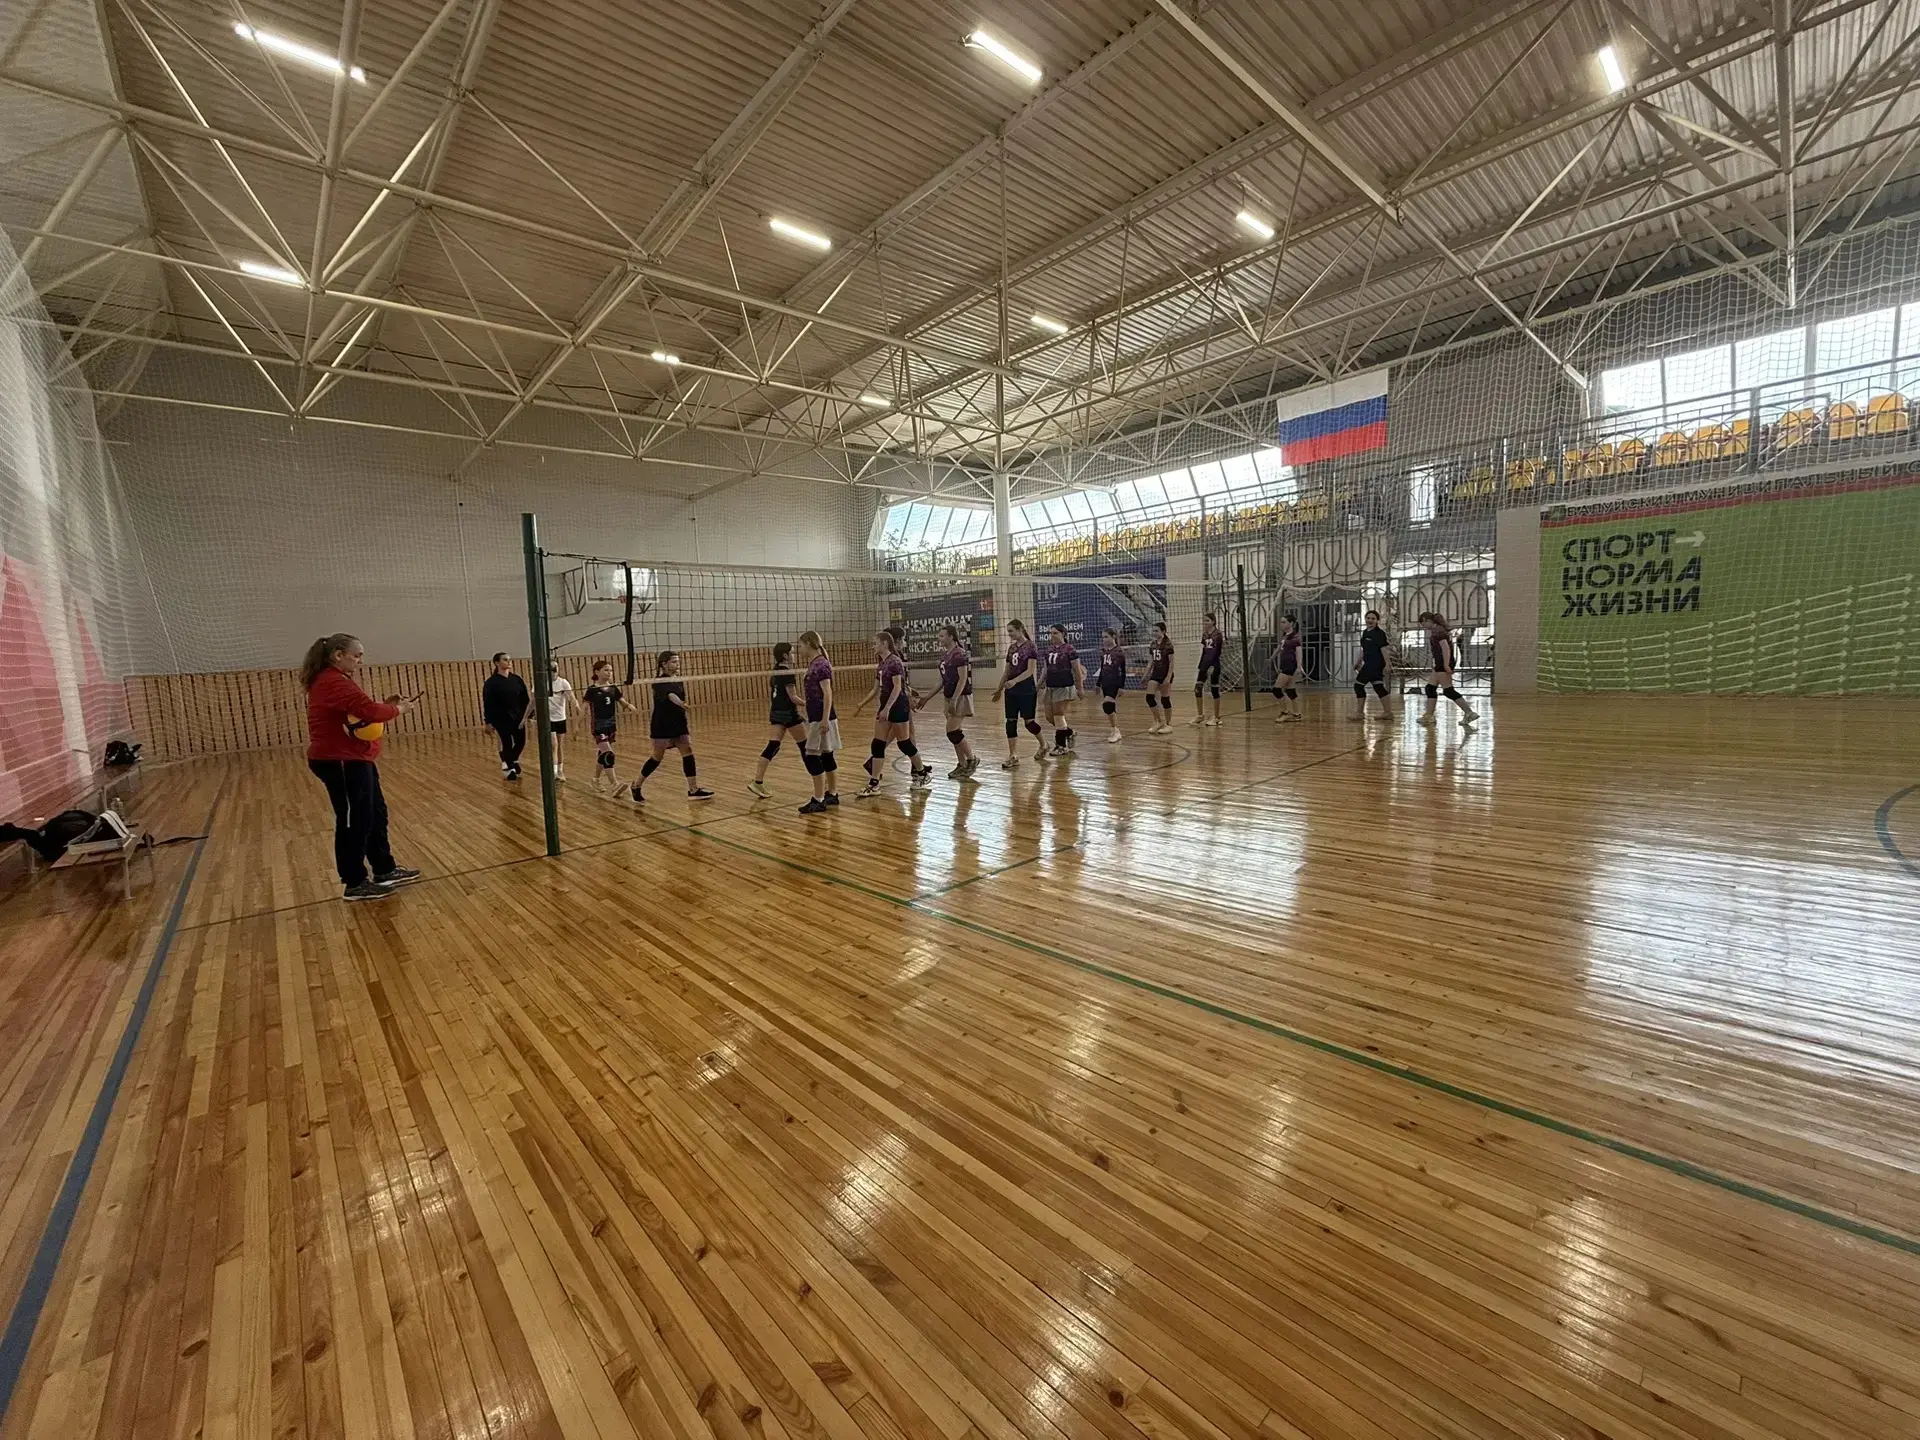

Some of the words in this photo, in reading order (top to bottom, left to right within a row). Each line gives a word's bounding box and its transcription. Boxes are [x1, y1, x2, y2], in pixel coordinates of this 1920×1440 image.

[1567, 491, 1677, 517] ВАЛУЙСКИЙ
[1684, 460, 1898, 503] МУНИЦИПАЛЬНЫЙ
[1562, 529, 1676, 562] СПОРТ
[1562, 556, 1702, 591] НОРМА
[1561, 586, 1700, 618] ЖИЗНИ
[1012, 652, 1019, 665] 8
[1048, 652, 1058, 664] 11
[1152, 649, 1162, 660] 15
[605, 696, 611, 705] 3
